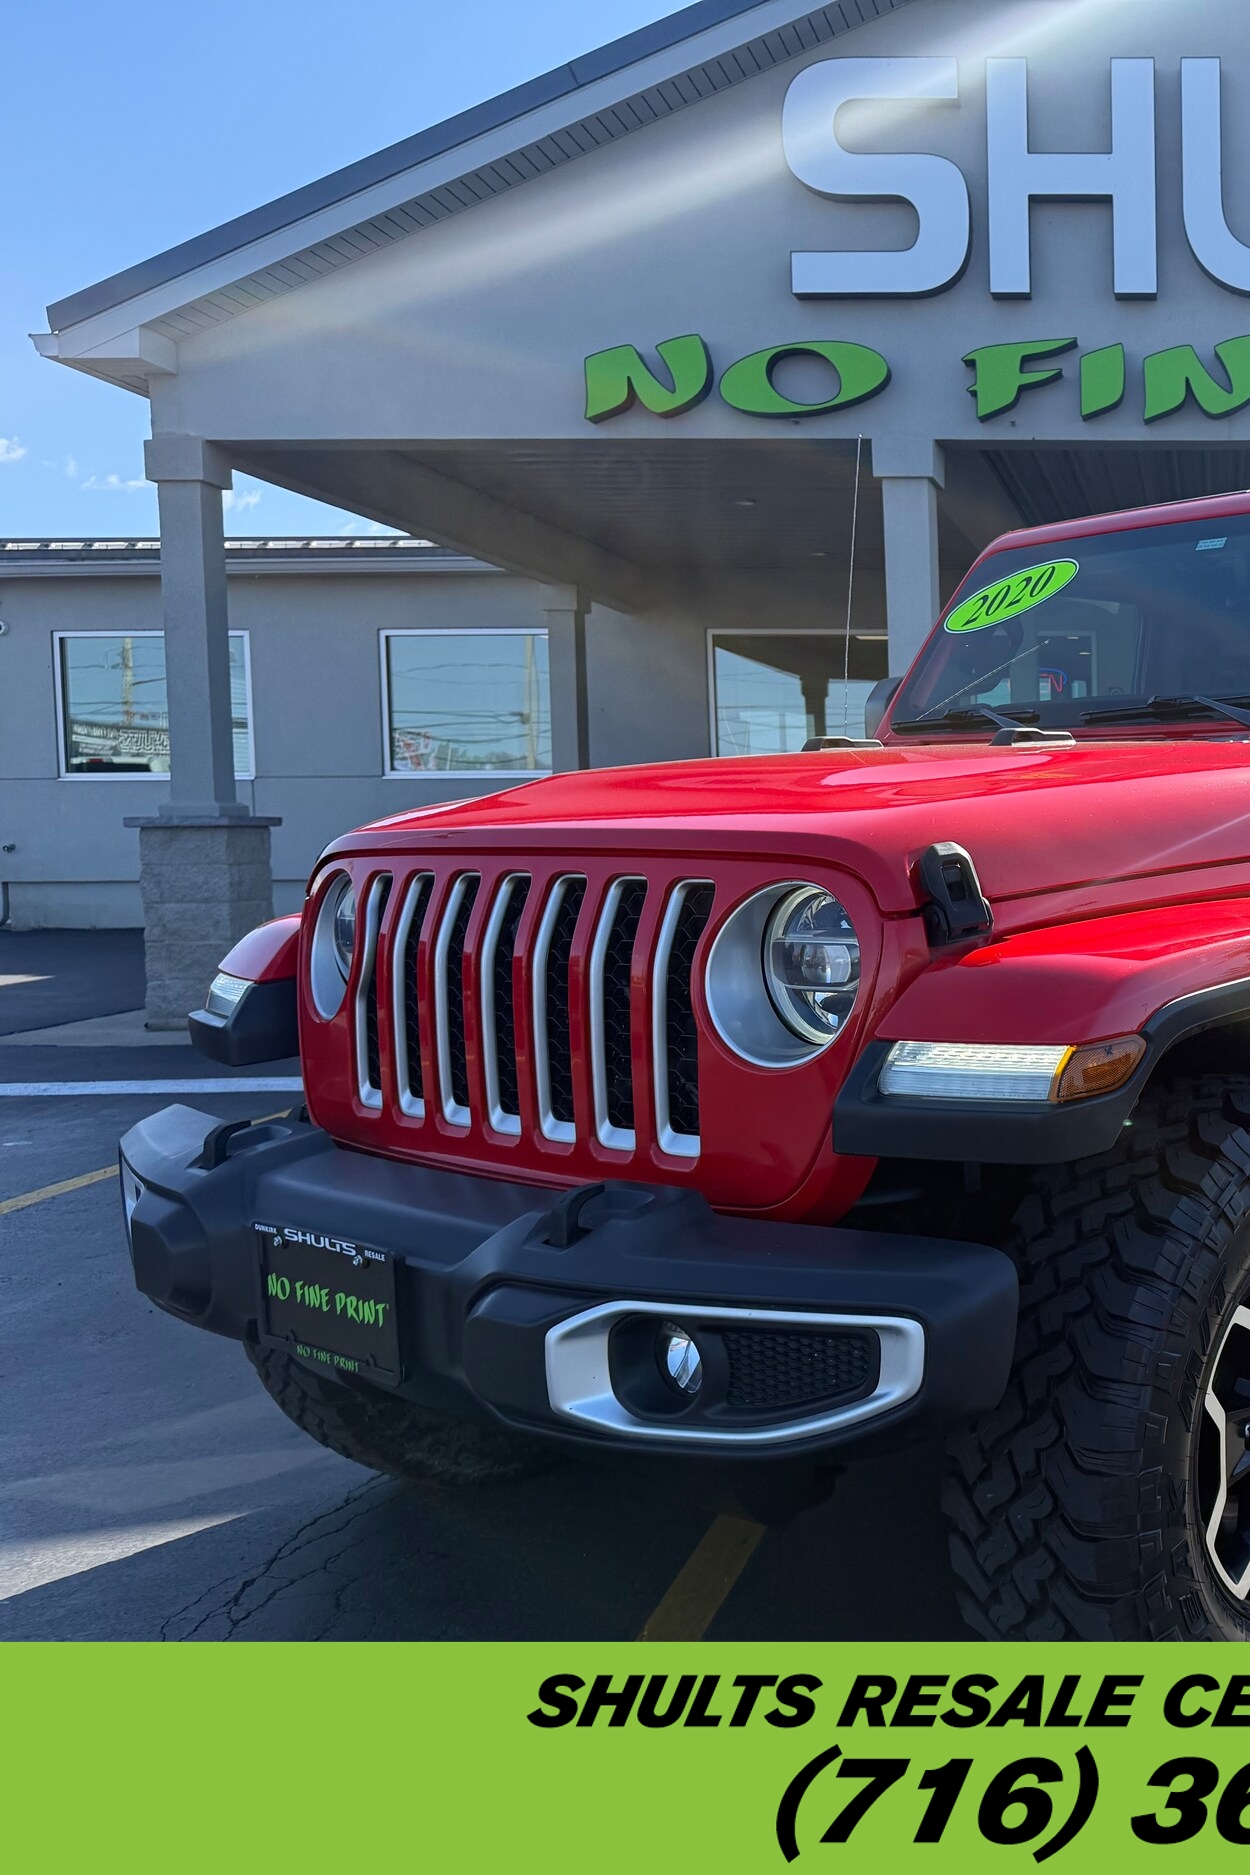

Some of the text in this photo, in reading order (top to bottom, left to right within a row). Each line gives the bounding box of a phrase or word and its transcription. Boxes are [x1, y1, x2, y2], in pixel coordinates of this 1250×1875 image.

[584, 334, 893, 423] NO
[960, 565, 1056, 628] 2020
[254, 1223, 386, 1262] DUNKIRK SHULTS RESALE
[267, 1272, 387, 1329] NO FINE PRINT
[297, 1344, 360, 1373] NO FINE PRINT
